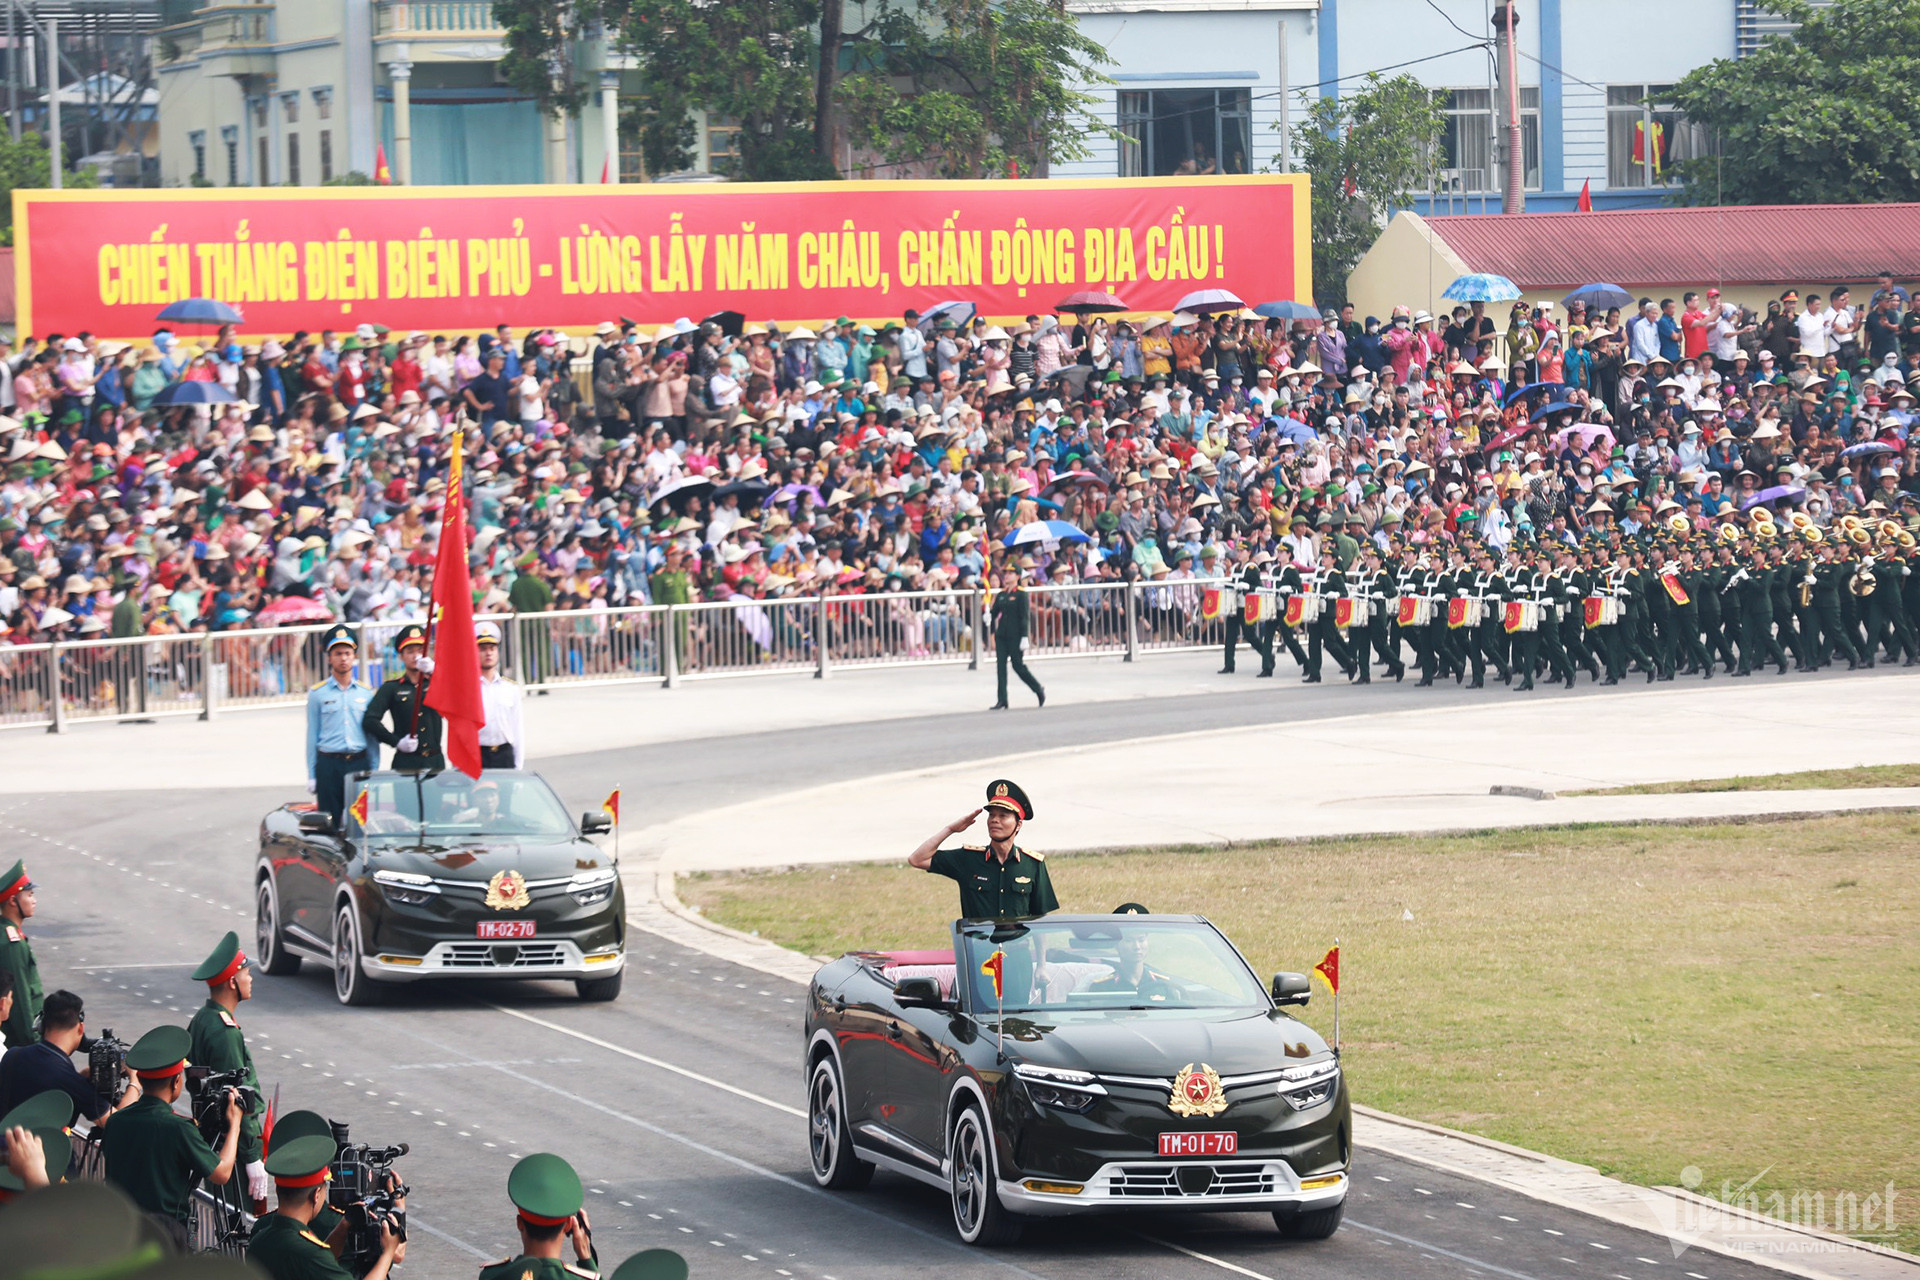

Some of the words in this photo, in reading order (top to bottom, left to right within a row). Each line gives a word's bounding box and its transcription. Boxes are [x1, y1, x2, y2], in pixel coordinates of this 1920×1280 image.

[98, 223, 191, 305] CHIẾN
[195, 219, 298, 303] THẮNG
[304, 228, 379, 314] ĐIỆN
[386, 226, 461, 299] BIÊN
[467, 217, 531, 296] PHỦ
[538, 263, 553, 277] -
[560, 223, 642, 295] LỪNG
[650, 212, 706, 292] LẪY
[716, 221, 788, 290] NĂM
[798, 219, 890, 294] CHÂU,
[898, 209, 982, 286] CHẤN
[990, 217, 1075, 297] ĐỘNG
[1083, 227, 1137, 295] ĐỊA
[479, 923, 535, 937] TM-02-70
[1161, 1134, 1235, 1154] TM-01-70
